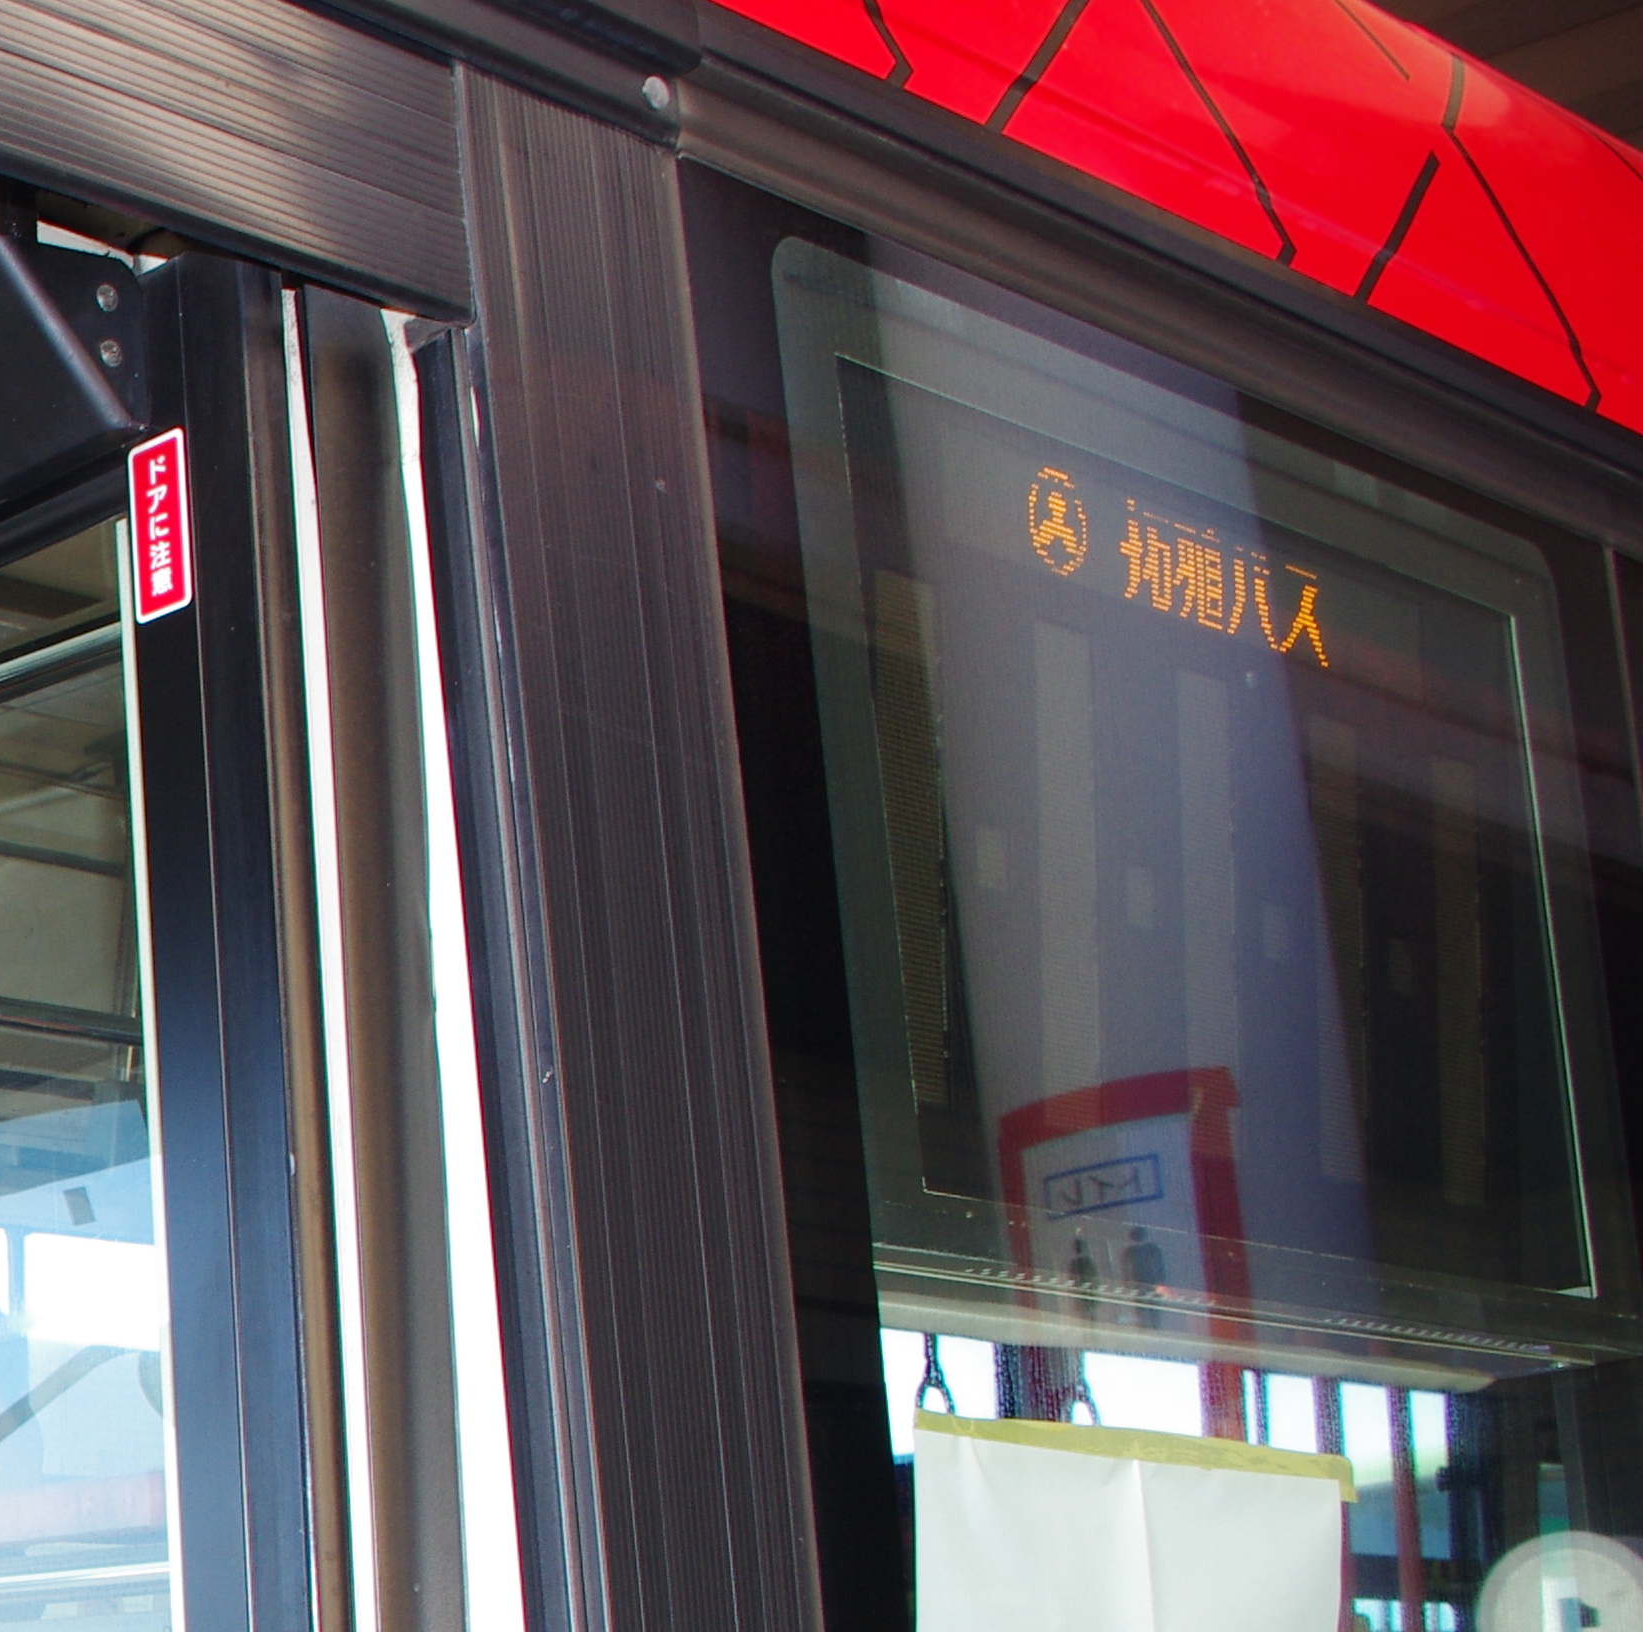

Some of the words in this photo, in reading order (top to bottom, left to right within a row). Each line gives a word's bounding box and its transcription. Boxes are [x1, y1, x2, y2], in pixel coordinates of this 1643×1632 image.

[146, 455, 174, 597] ドアに注意
[1120, 498, 1329, 668] 拓殖バス
